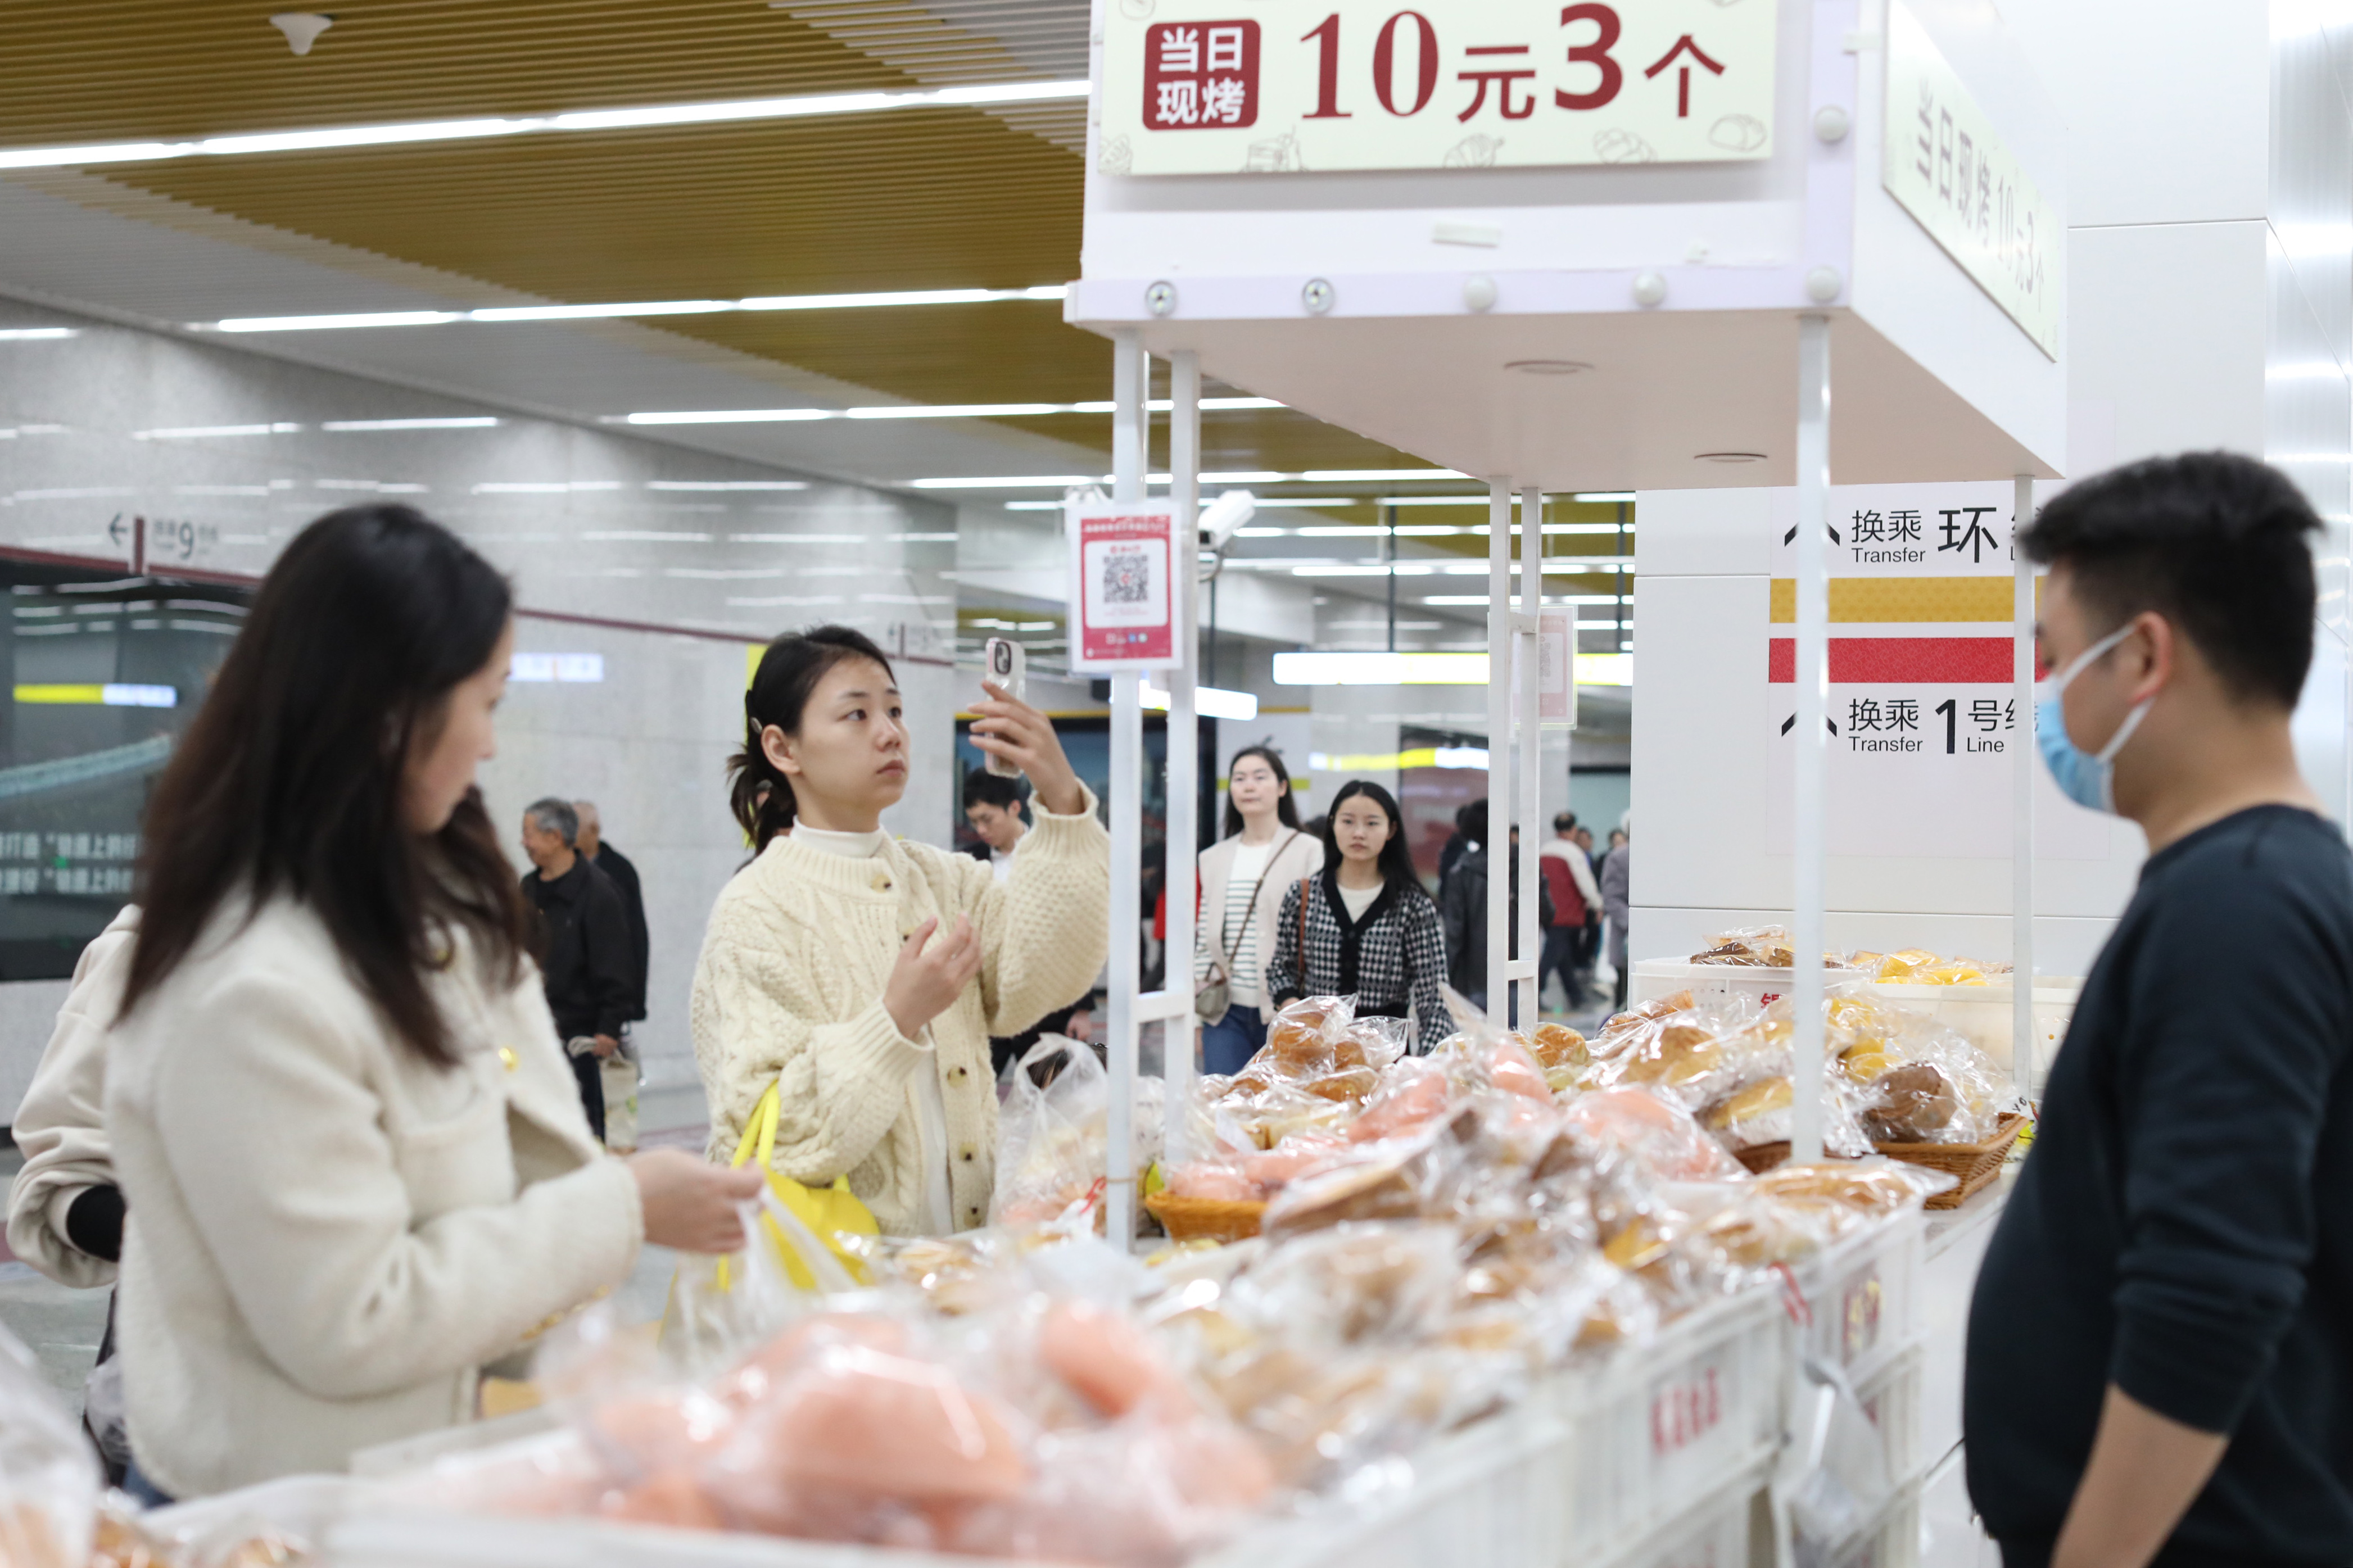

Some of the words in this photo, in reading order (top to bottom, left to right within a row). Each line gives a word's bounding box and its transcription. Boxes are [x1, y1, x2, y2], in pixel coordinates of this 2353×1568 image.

[1159, 26, 1243, 72] 当日
[1299, 2, 1726, 123] 10元3个
[1156, 76, 1246, 125] 现烤
[1851, 547, 1926, 563] Transfer
[1852, 510, 1922, 543] 换乘
[1937, 507, 2015, 563] 环
[1848, 698, 1919, 732] 换乘
[1848, 736, 1923, 752] Transfer
[1967, 737, 2004, 752] Line
